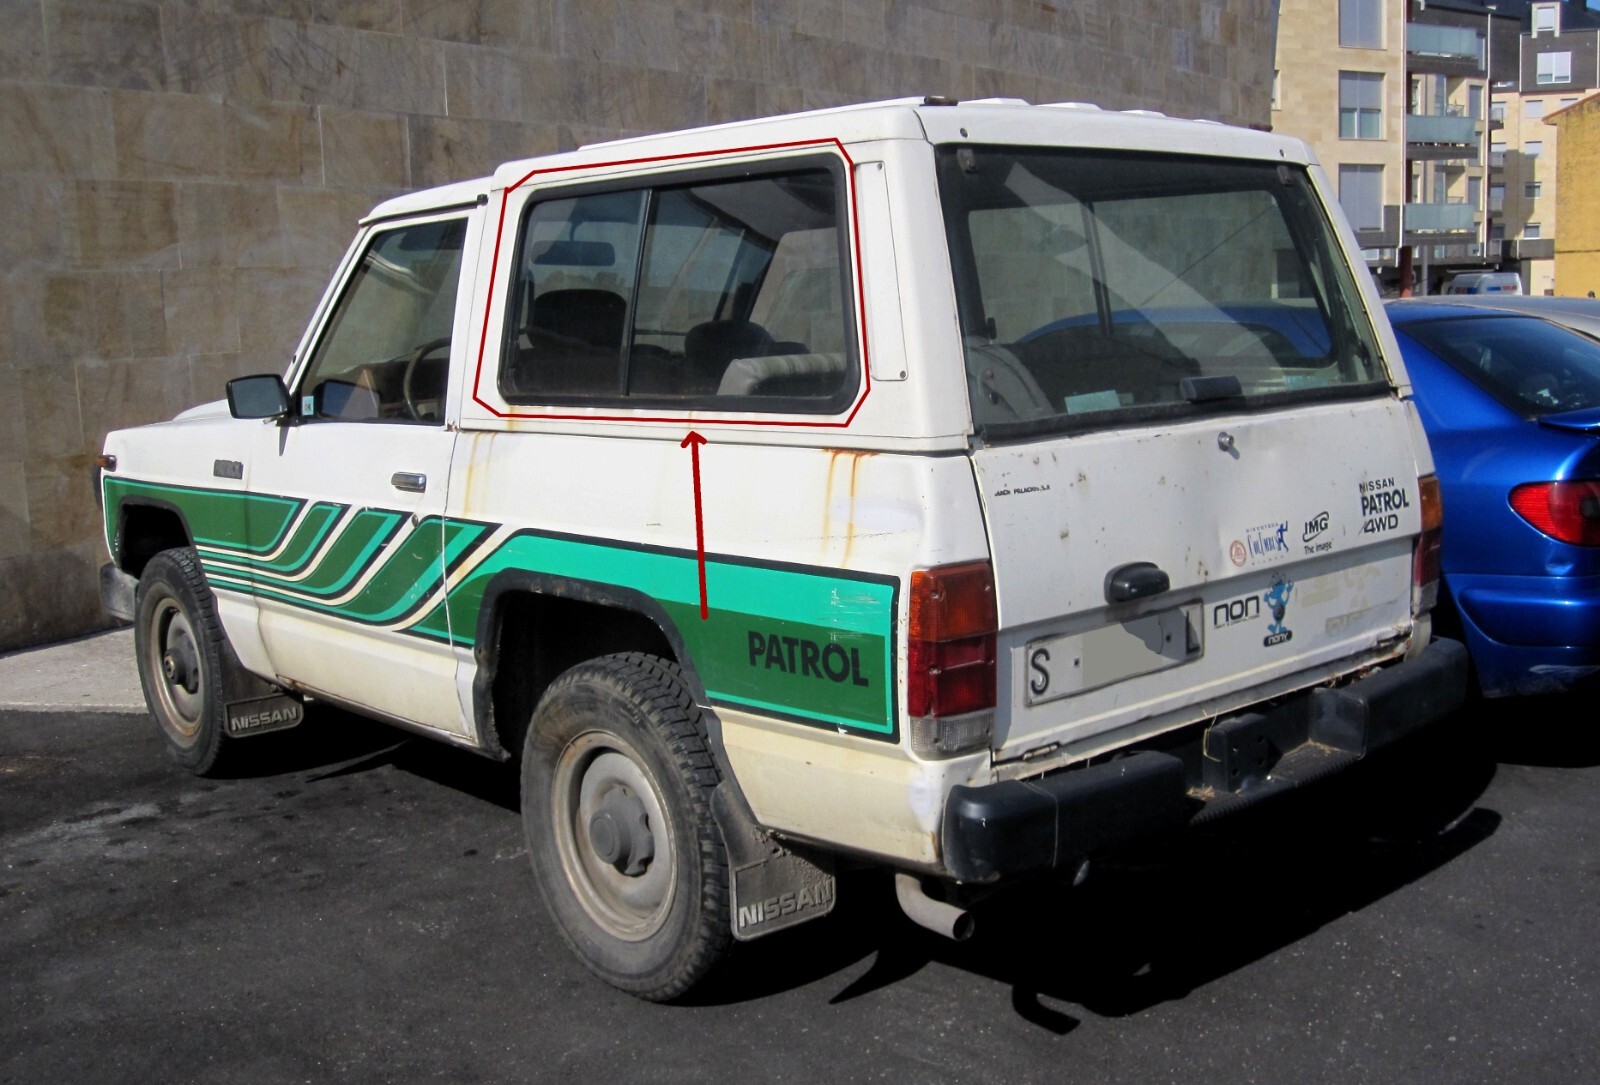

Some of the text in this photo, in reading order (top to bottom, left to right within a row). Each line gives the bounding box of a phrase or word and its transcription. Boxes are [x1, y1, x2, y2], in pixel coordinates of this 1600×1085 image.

[1359, 477, 1395, 493] NISSAN
[1361, 488, 1410, 517] PATROL
[1304, 517, 1328, 534] IMG
[1363, 513, 1399, 533] 4WD
[748, 631, 869, 687] PATROL
[1031, 648, 1050, 695] S
[231, 706, 297, 731] NISSAN
[739, 880, 832, 928] NISSAN
